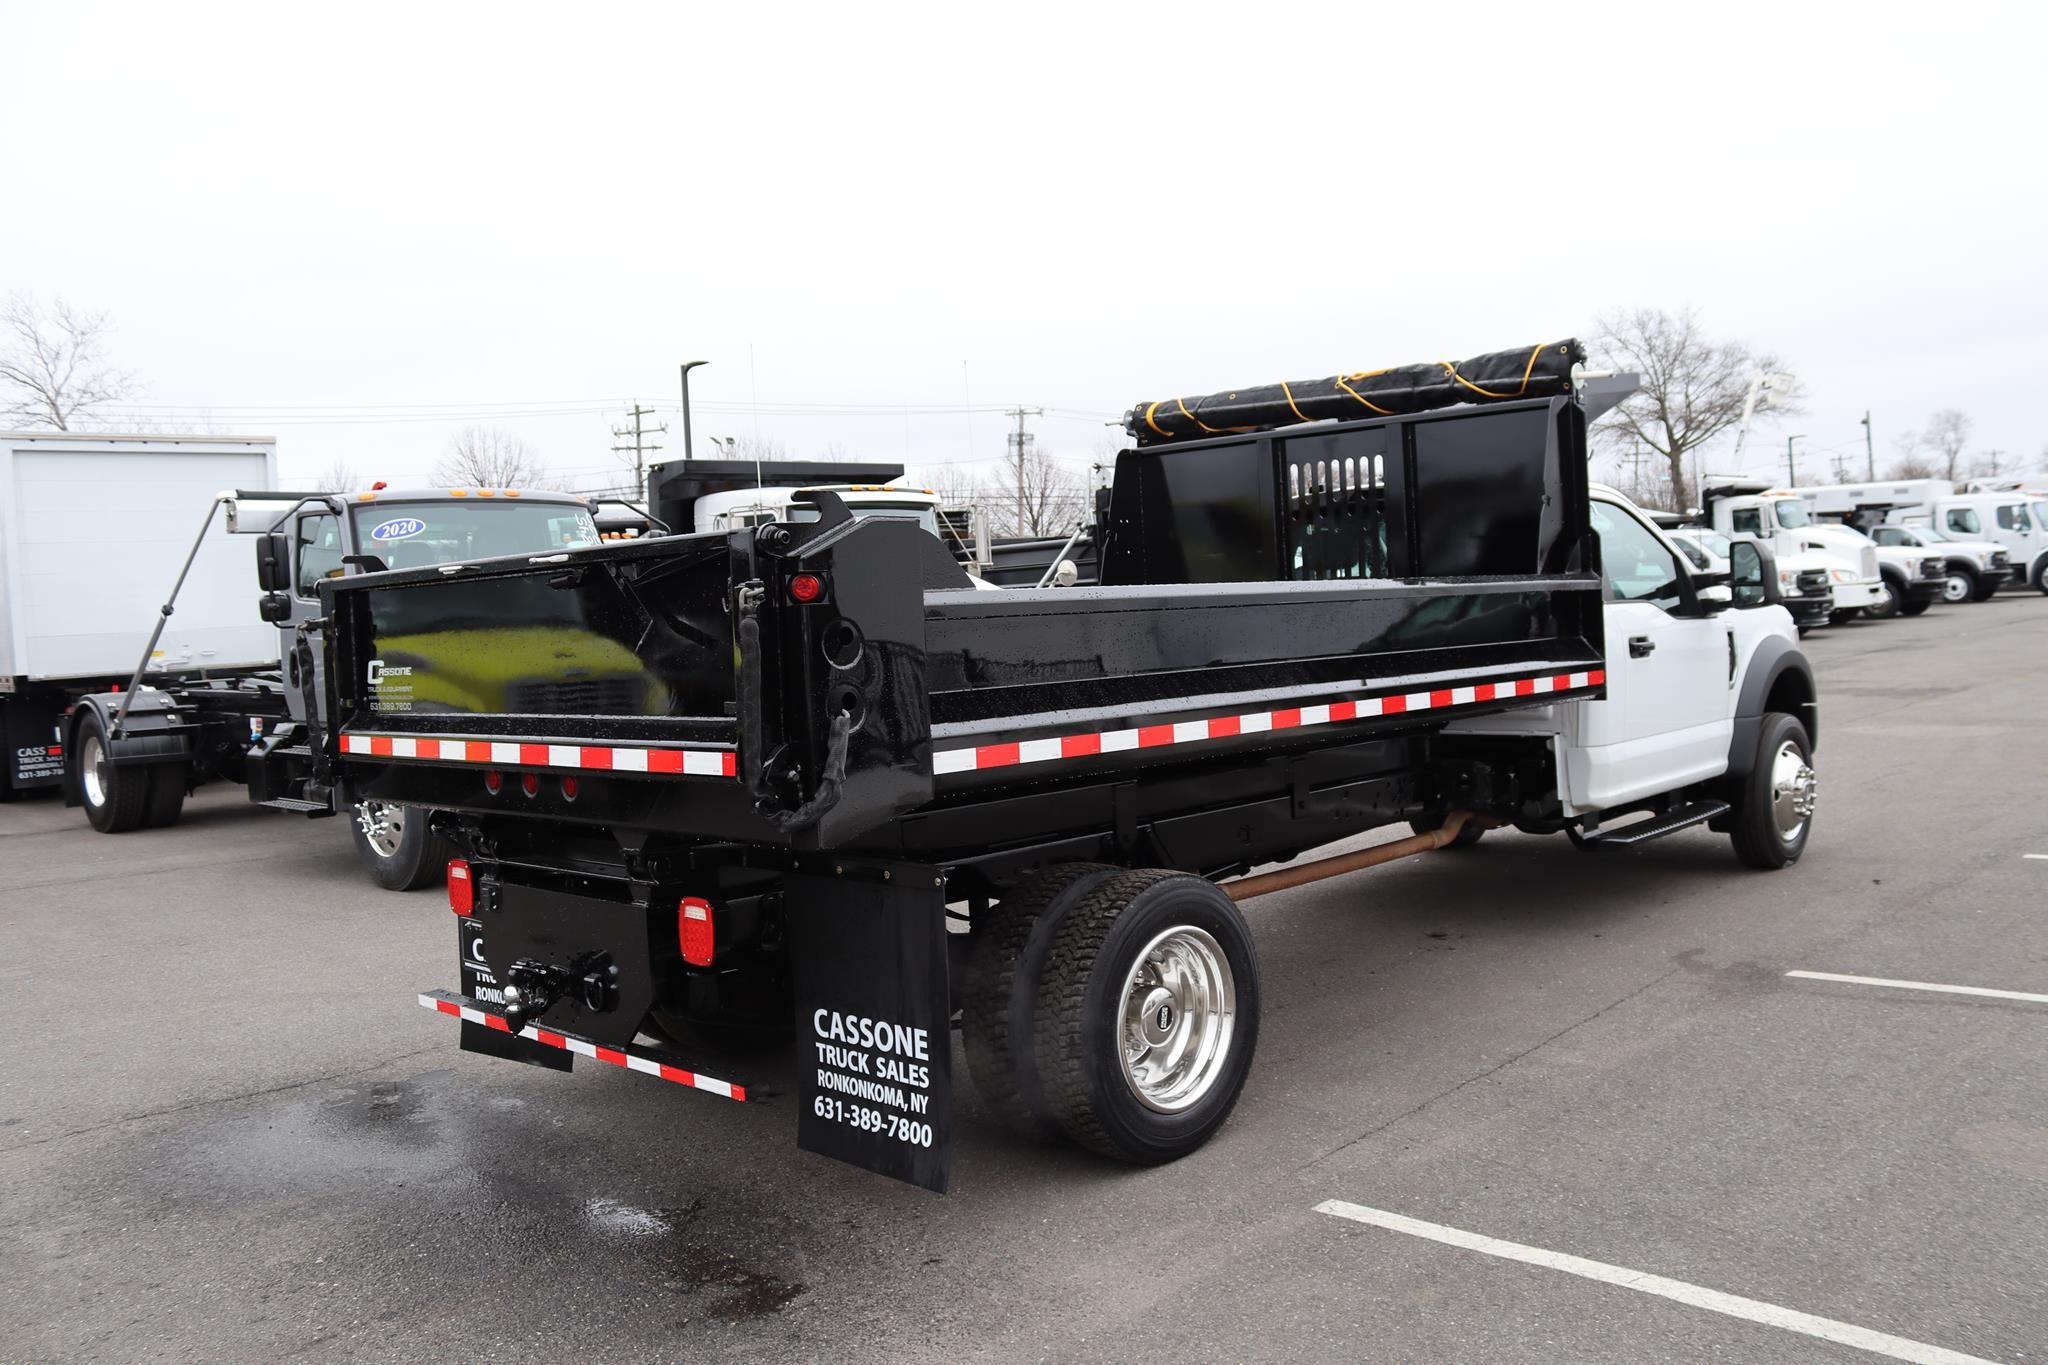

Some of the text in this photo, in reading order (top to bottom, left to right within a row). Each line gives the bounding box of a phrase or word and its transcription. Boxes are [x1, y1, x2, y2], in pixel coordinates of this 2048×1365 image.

[382, 520, 417, 538] 2020
[367, 660, 412, 684] CASSONE
[17, 746, 47, 757] CASS
[813, 1008, 930, 1062] CASSONE
[815, 1041, 930, 1089] TRUCK SALES
[817, 1068, 929, 1115] RONKONKOMA, NY
[814, 1095, 933, 1148] 631-389-7800
